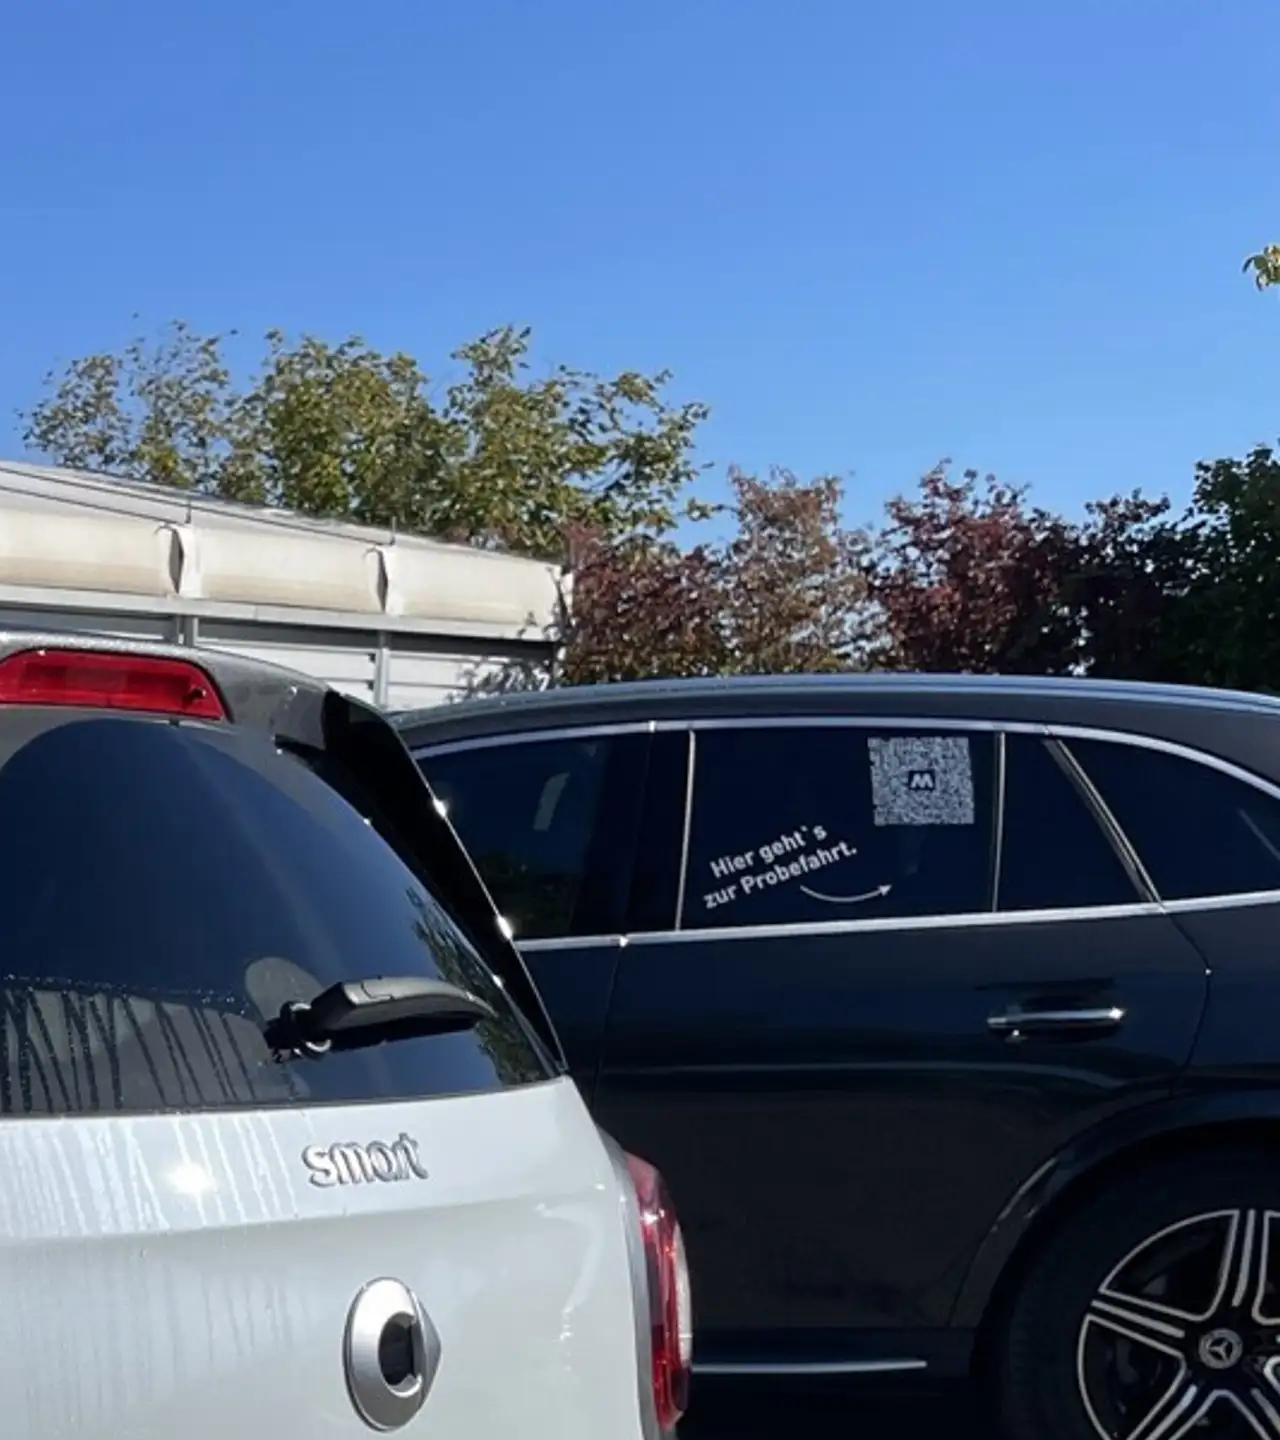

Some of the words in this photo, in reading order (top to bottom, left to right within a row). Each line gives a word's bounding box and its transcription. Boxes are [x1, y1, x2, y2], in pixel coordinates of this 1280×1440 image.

[703, 886, 737, 909] zur
[740, 840, 858, 896] Probefahrt.
[709, 846, 754, 878] Hier
[301, 1132, 430, 1188] smart
